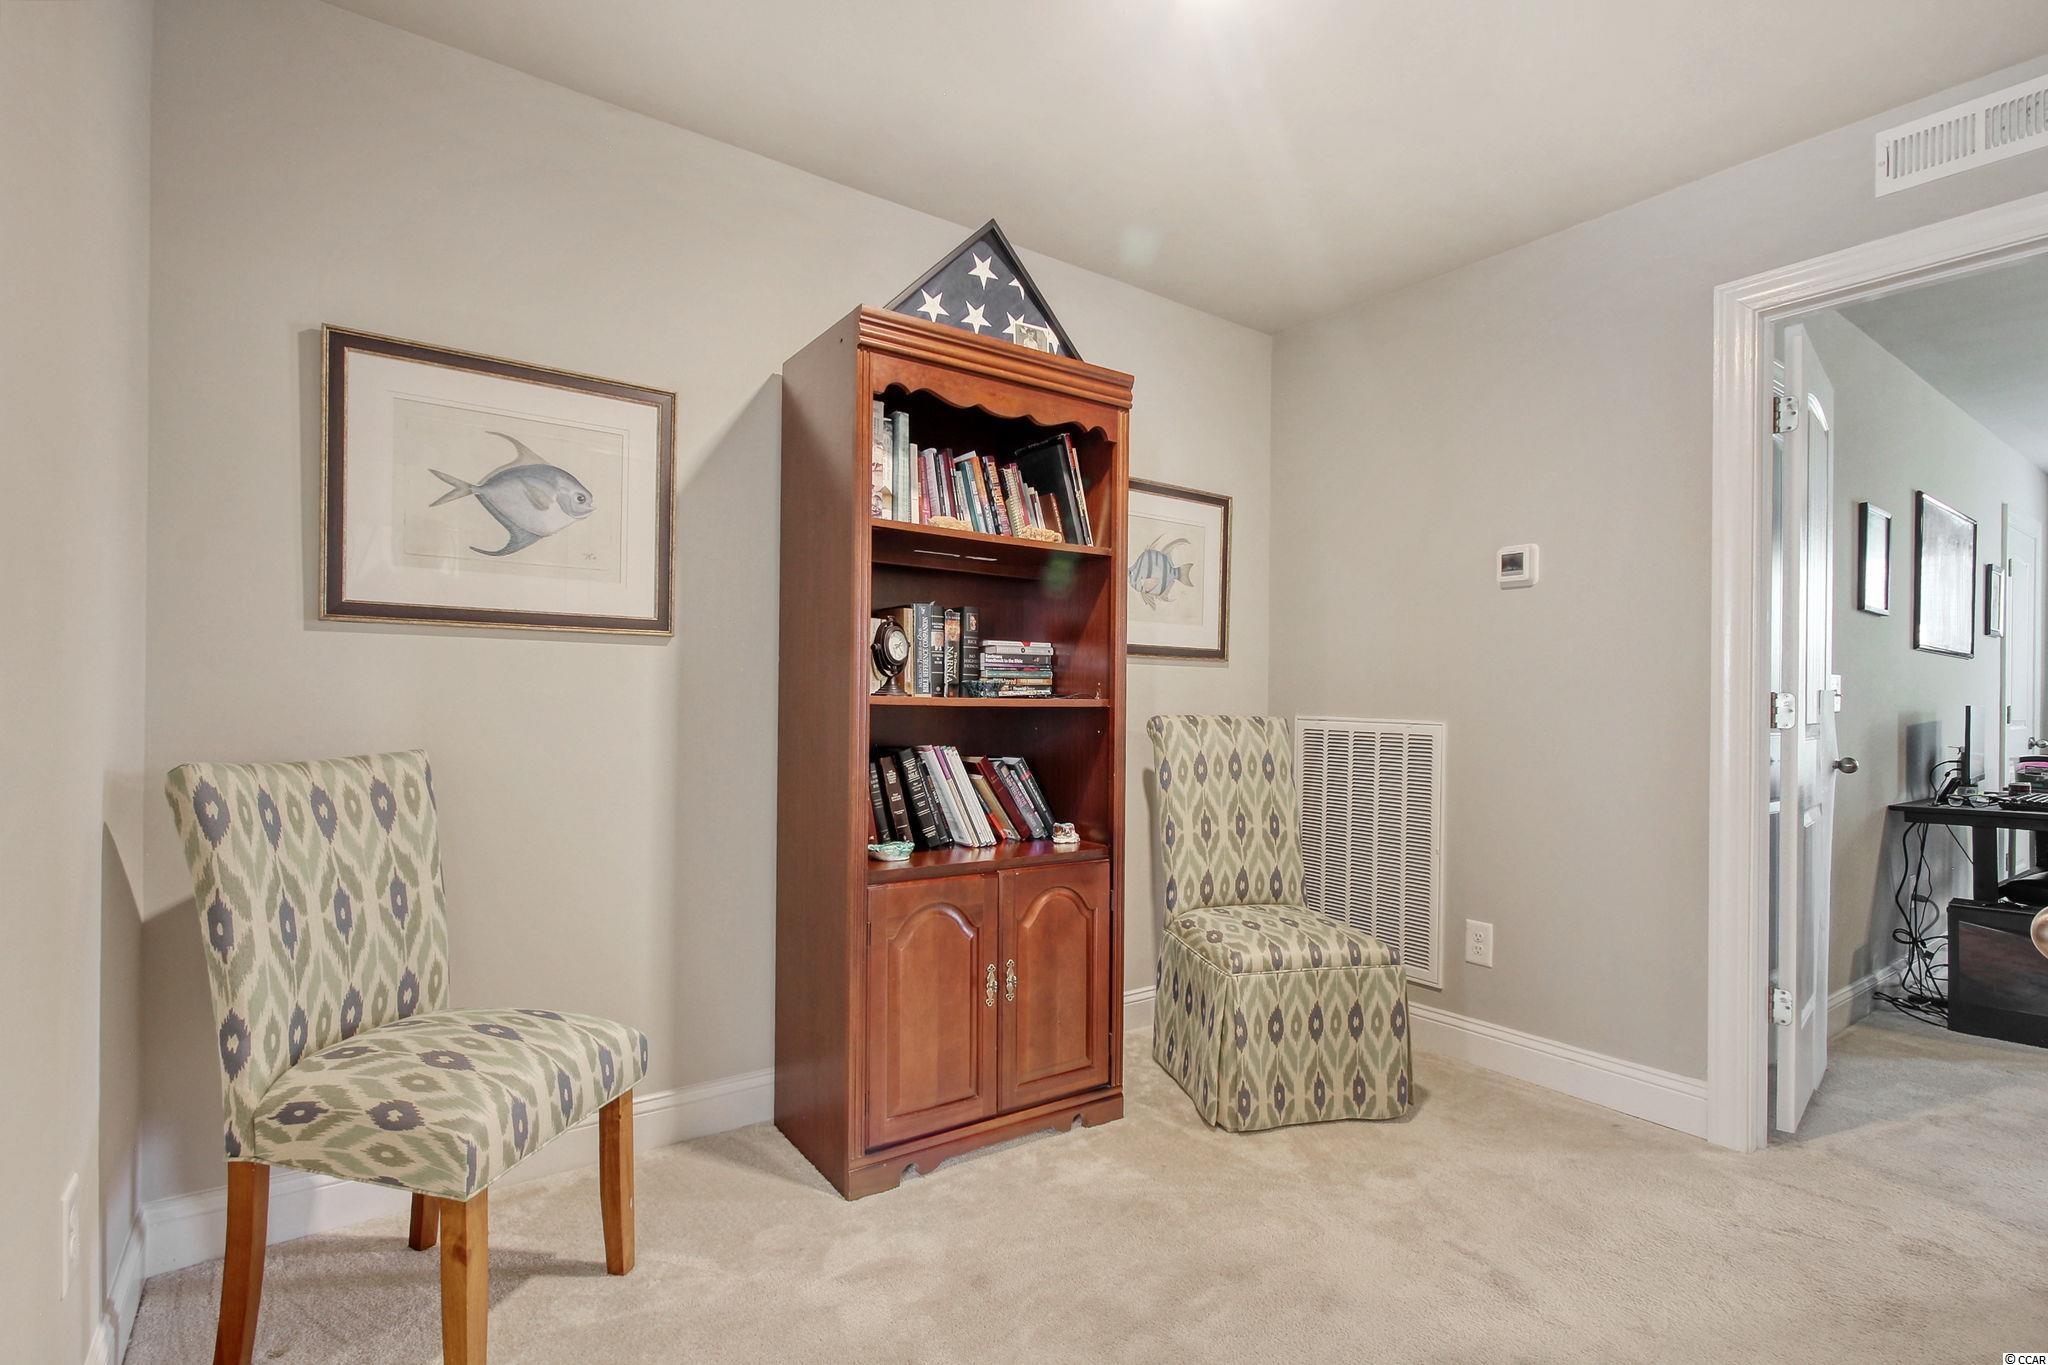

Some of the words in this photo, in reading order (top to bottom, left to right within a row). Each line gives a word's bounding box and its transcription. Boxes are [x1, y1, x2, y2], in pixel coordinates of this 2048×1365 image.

[922, 648, 930, 678] REFERENCE
[946, 646, 954, 683] NARNIA
[922, 678, 930, 693] BIBLE
